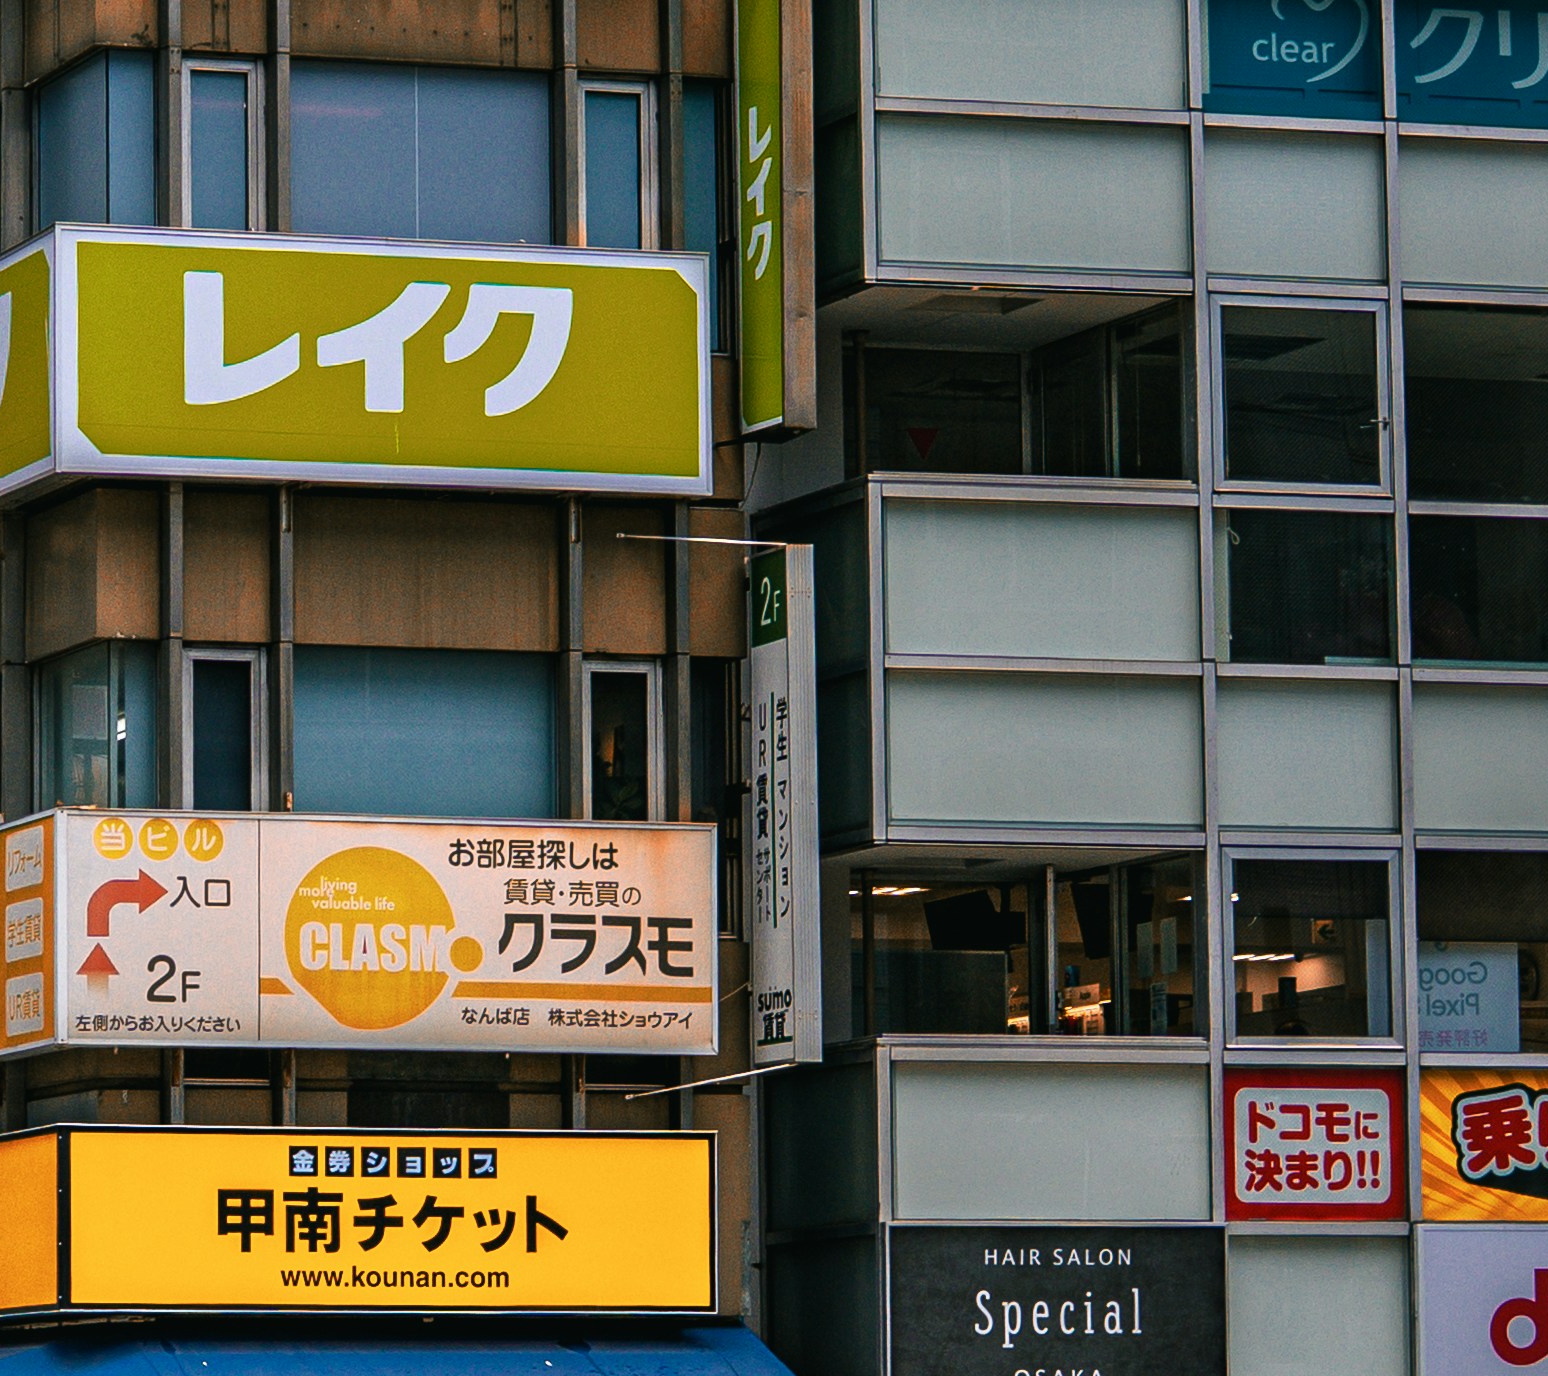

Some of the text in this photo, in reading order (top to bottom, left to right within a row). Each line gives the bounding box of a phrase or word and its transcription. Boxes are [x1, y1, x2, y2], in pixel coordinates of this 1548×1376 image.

[1252, 31, 1334, 68] clear
[746, 105, 772, 280] レイク
[183, 269, 575, 418] レイク
[759, 575, 781, 627] 2F
[775, 696, 791, 918] 学生 マンション
[96, 820, 222, 856] 当ビル
[449, 838, 619, 871] お部屋探しは
[169, 874, 232, 909] 入口
[319, 874, 358, 894] living
[503, 879, 642, 908] 賃貸・売買の
[312, 895, 396, 912] valuable life
[498, 913, 694, 978] クラスモ
[145, 953, 202, 1004] 2F
[75, 1013, 241, 1034] 左側からお入りください
[460, 1007, 693, 1030] なんば店 株式会社ショウアイ
[762, 1011, 790, 1042] 賃貸
[1244, 1099, 1382, 1150] ドコモに
[289, 1146, 497, 1178] 金券ショップ
[1244, 1148, 1384, 1195] 決まり!!
[216, 1186, 570, 1256] 甲南チケット
[982, 1247, 1134, 1267] HAIR SALON
[280, 1265, 510, 1290] www.kounan.com
[973, 1286, 1145, 1345] Special
